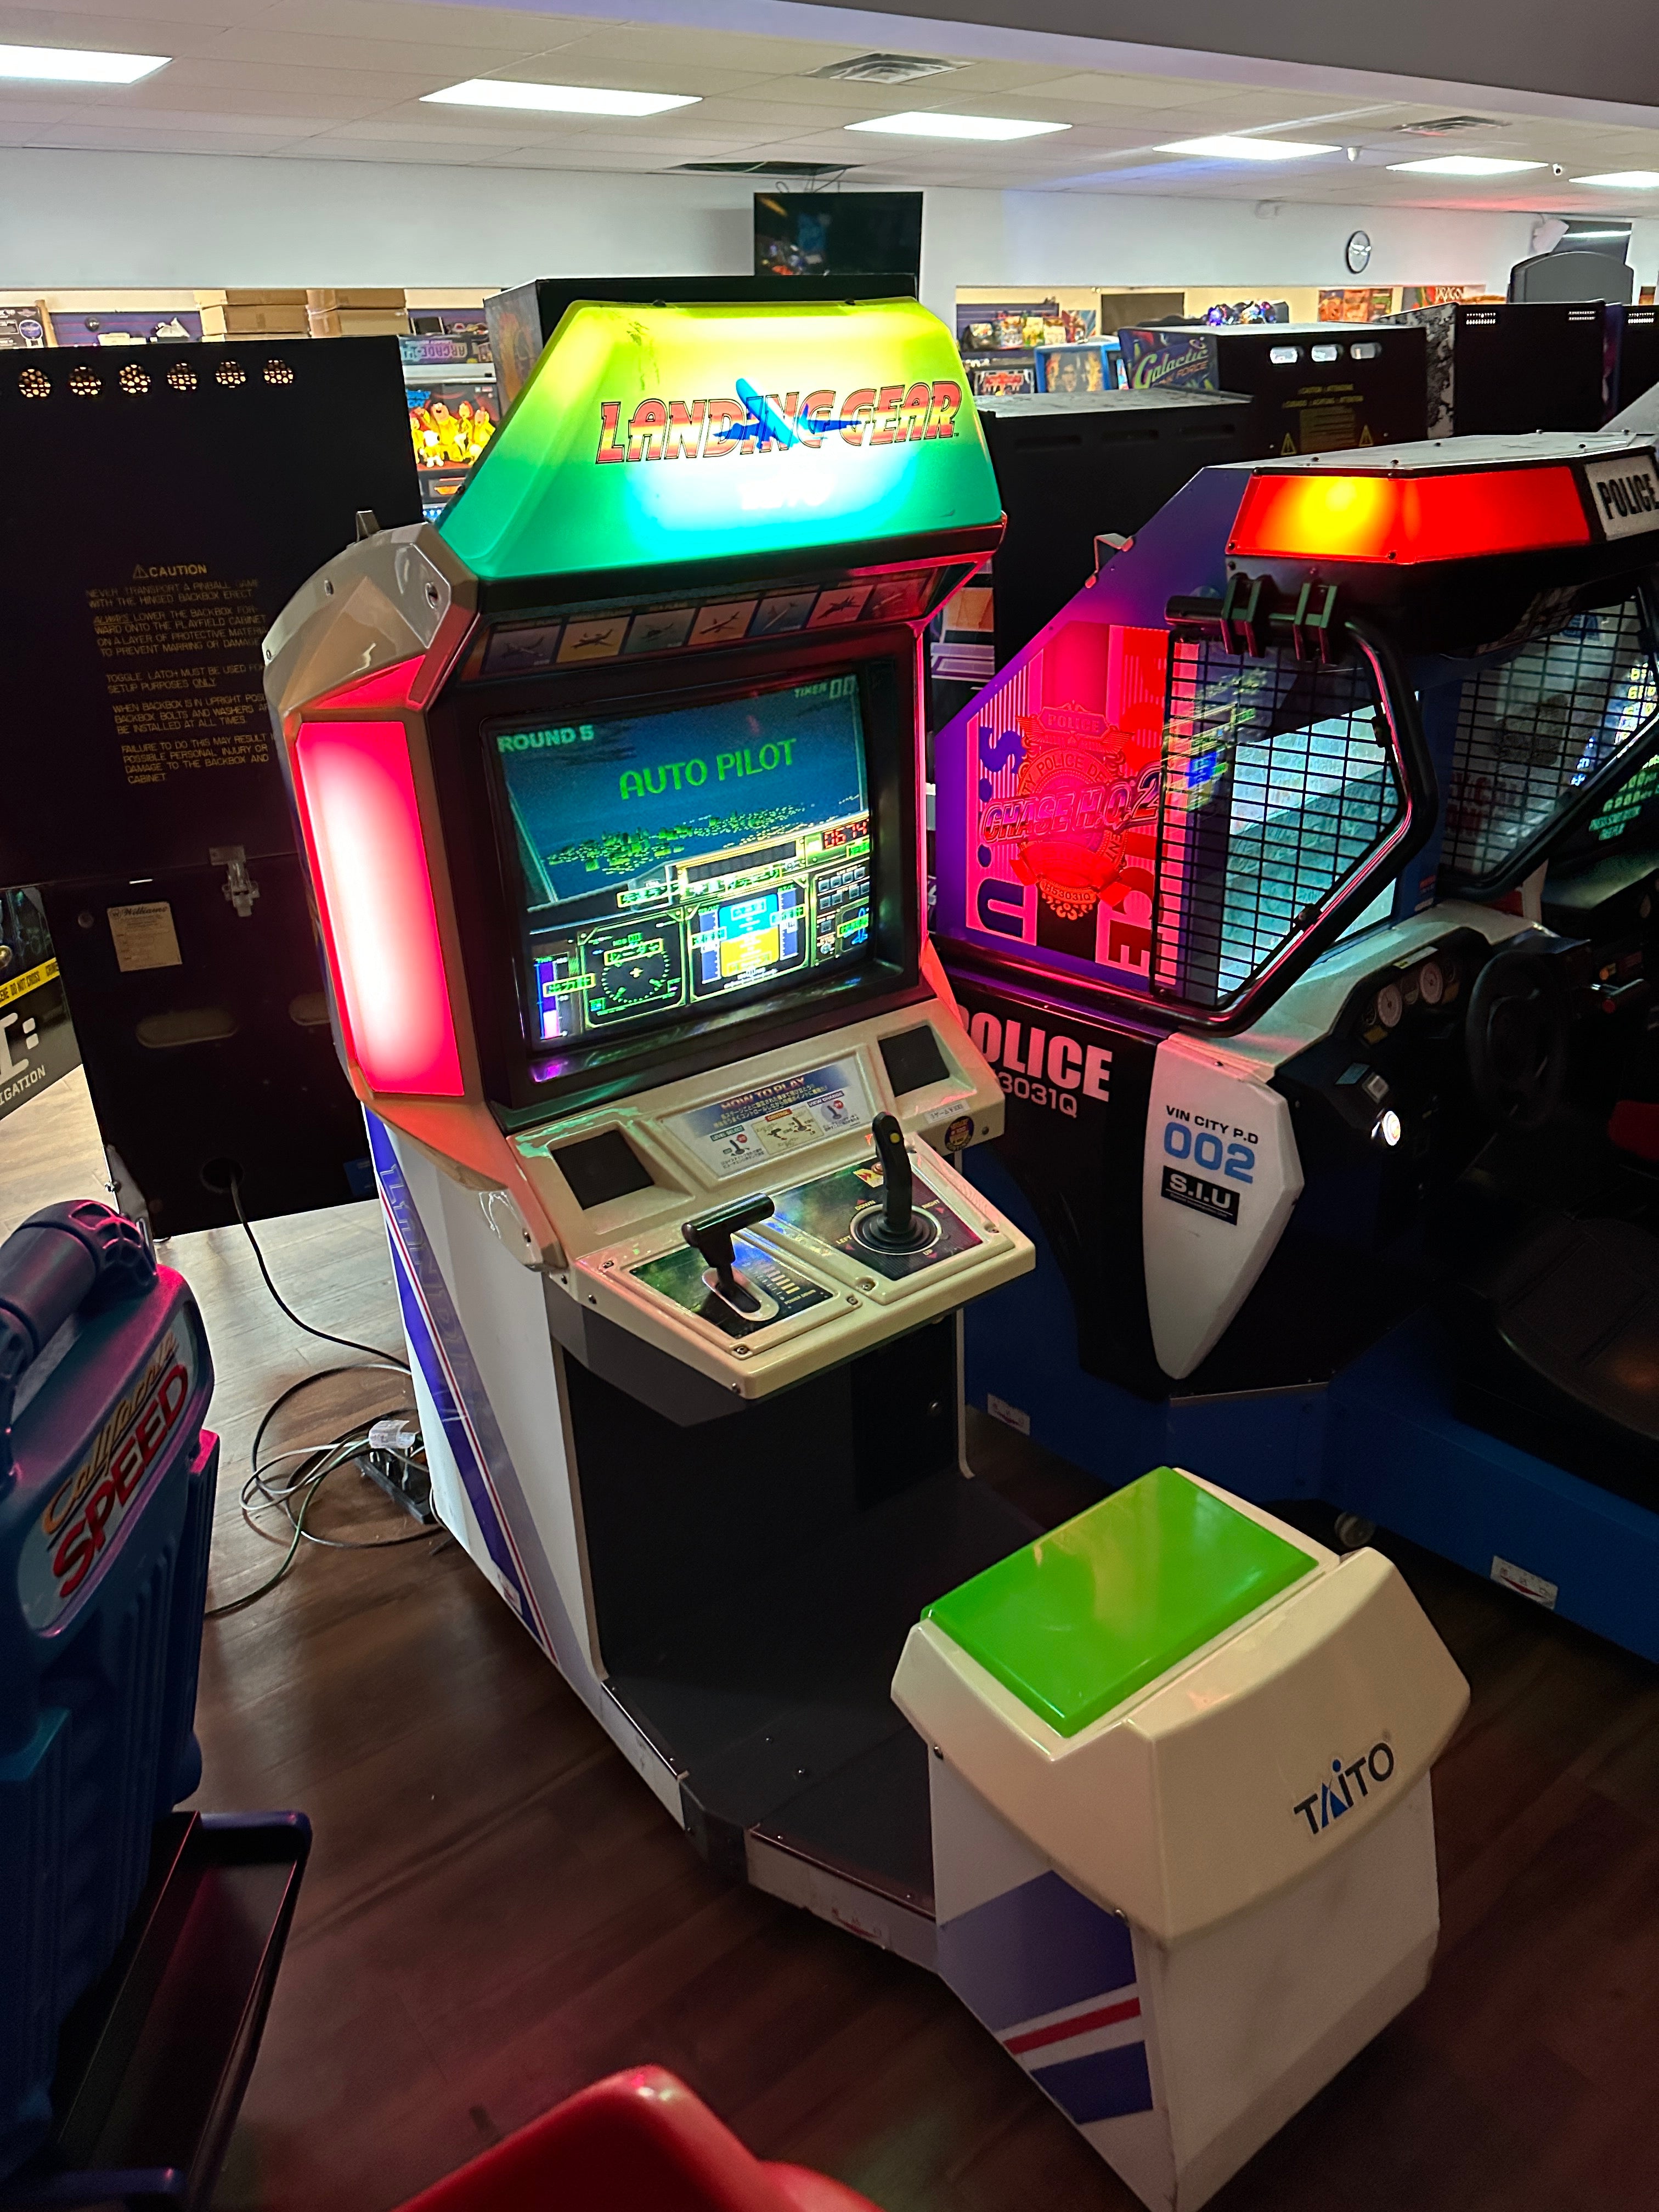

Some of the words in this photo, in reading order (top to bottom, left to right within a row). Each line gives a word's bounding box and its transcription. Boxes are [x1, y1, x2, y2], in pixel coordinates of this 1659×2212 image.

[1135, 349, 1209, 389] Galactic
[595, 390, 835, 464] LANDING
[839, 381, 962, 447] GEAR
[1596, 473, 1659, 520] POLICE
[149, 563, 208, 578] CAUTION
[497, 728, 574, 753] ROUND
[579, 724, 595, 742] 5
[1047, 714, 1100, 733] POLICE
[619, 758, 707, 800] AUTO
[716, 738, 797, 781] PILOT
[1036, 754, 1085, 775] POLICE
[981, 792, 1075, 842] CHASE
[1131, 764, 1161, 821] 2
[1044, 883, 1091, 901] H53031Q
[122, 905, 168, 917] Williams
[720, 1094, 754, 1110] HOW
[755, 1087, 772, 1099] TO
[774, 1076, 805, 1094] PLAY
[997, 1070, 1078, 1119] 3031Q
[1166, 1105, 1190, 1122] VIN
[1194, 1115, 1229, 1134] CITY
[1233, 1127, 1259, 1144] P.D
[1164, 1121, 1255, 1185] 002
[854, 1200, 876, 1211] DOWN
[921, 1199, 940, 1209] RIGHT
[1169, 1173, 1231, 1209] S.I.U
[836, 1235, 852, 1245] LEFT
[53, 1364, 189, 1599] SPEED
[1293, 1742, 1395, 1835] TAITO
